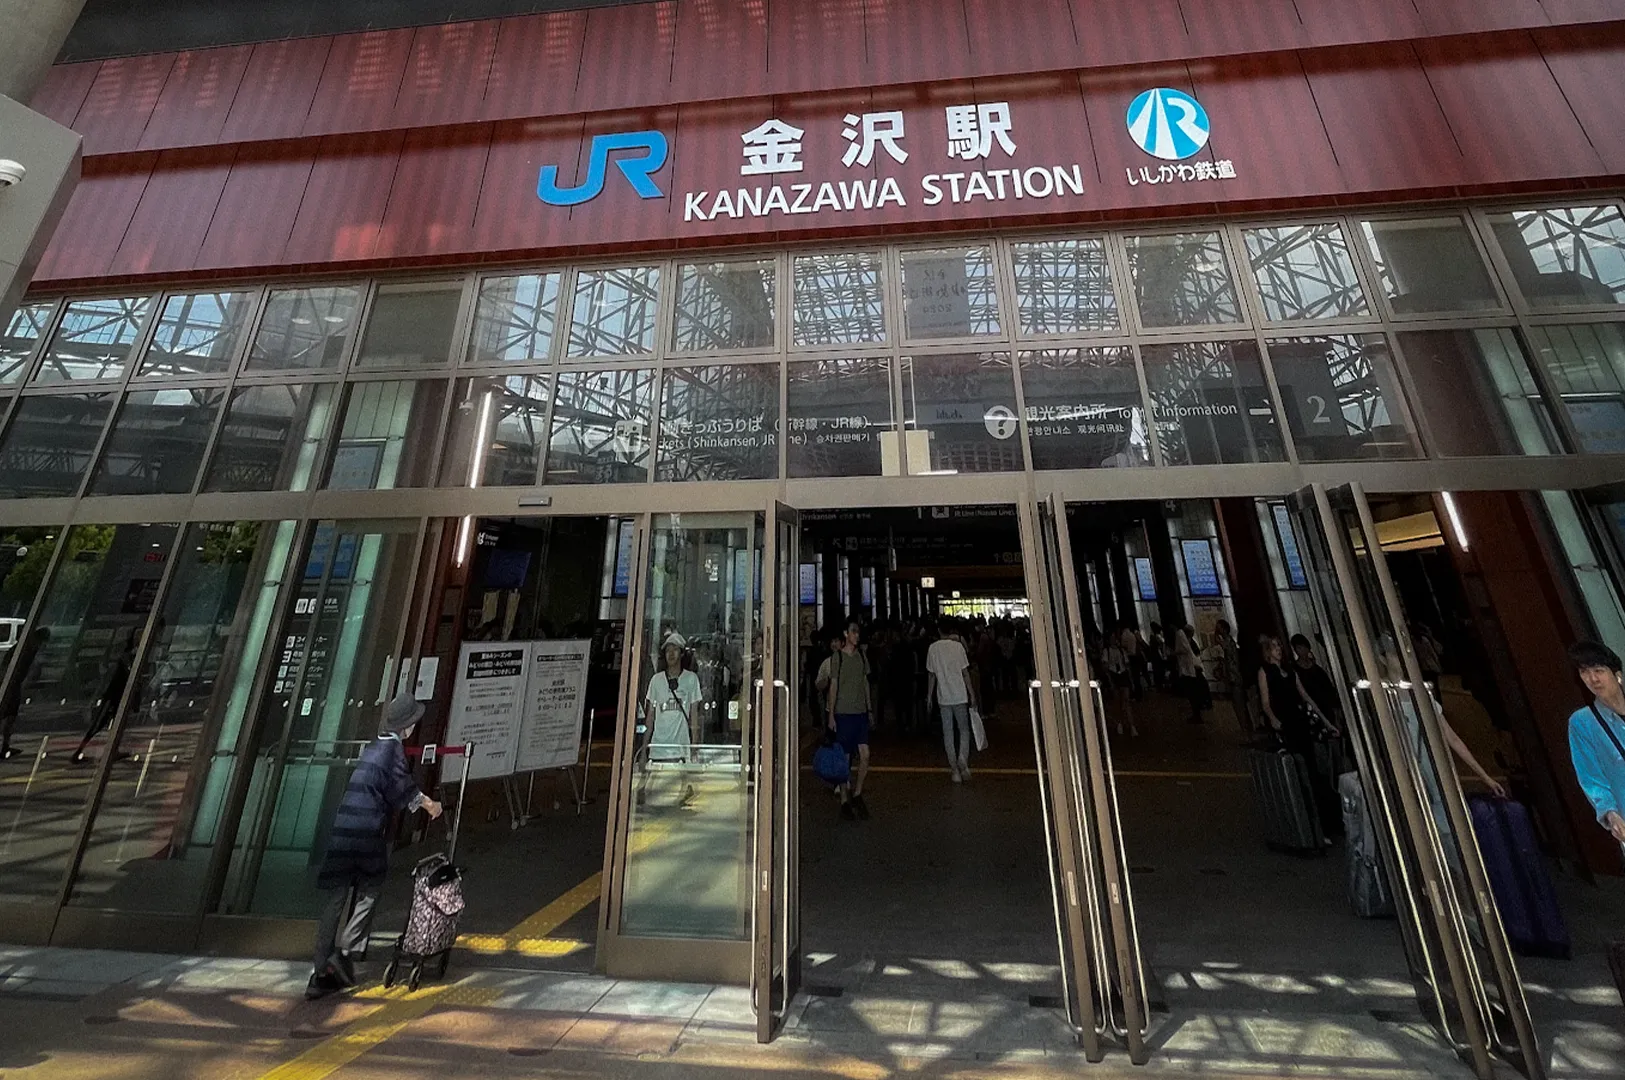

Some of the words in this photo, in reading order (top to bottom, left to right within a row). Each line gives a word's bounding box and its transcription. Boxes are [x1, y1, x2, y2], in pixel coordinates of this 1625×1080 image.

[740, 101, 1017, 175] 金沢駅
[536, 130, 668, 206] JR
[1126, 159, 1238, 186] いしかわ鉄道
[684, 176, 908, 221] KANAZAWA
[922, 164, 1085, 205] STATION
[1161, 402, 1238, 418] Information
[1306, 396, 1332, 424] 2
[763, 433, 775, 446] JR
